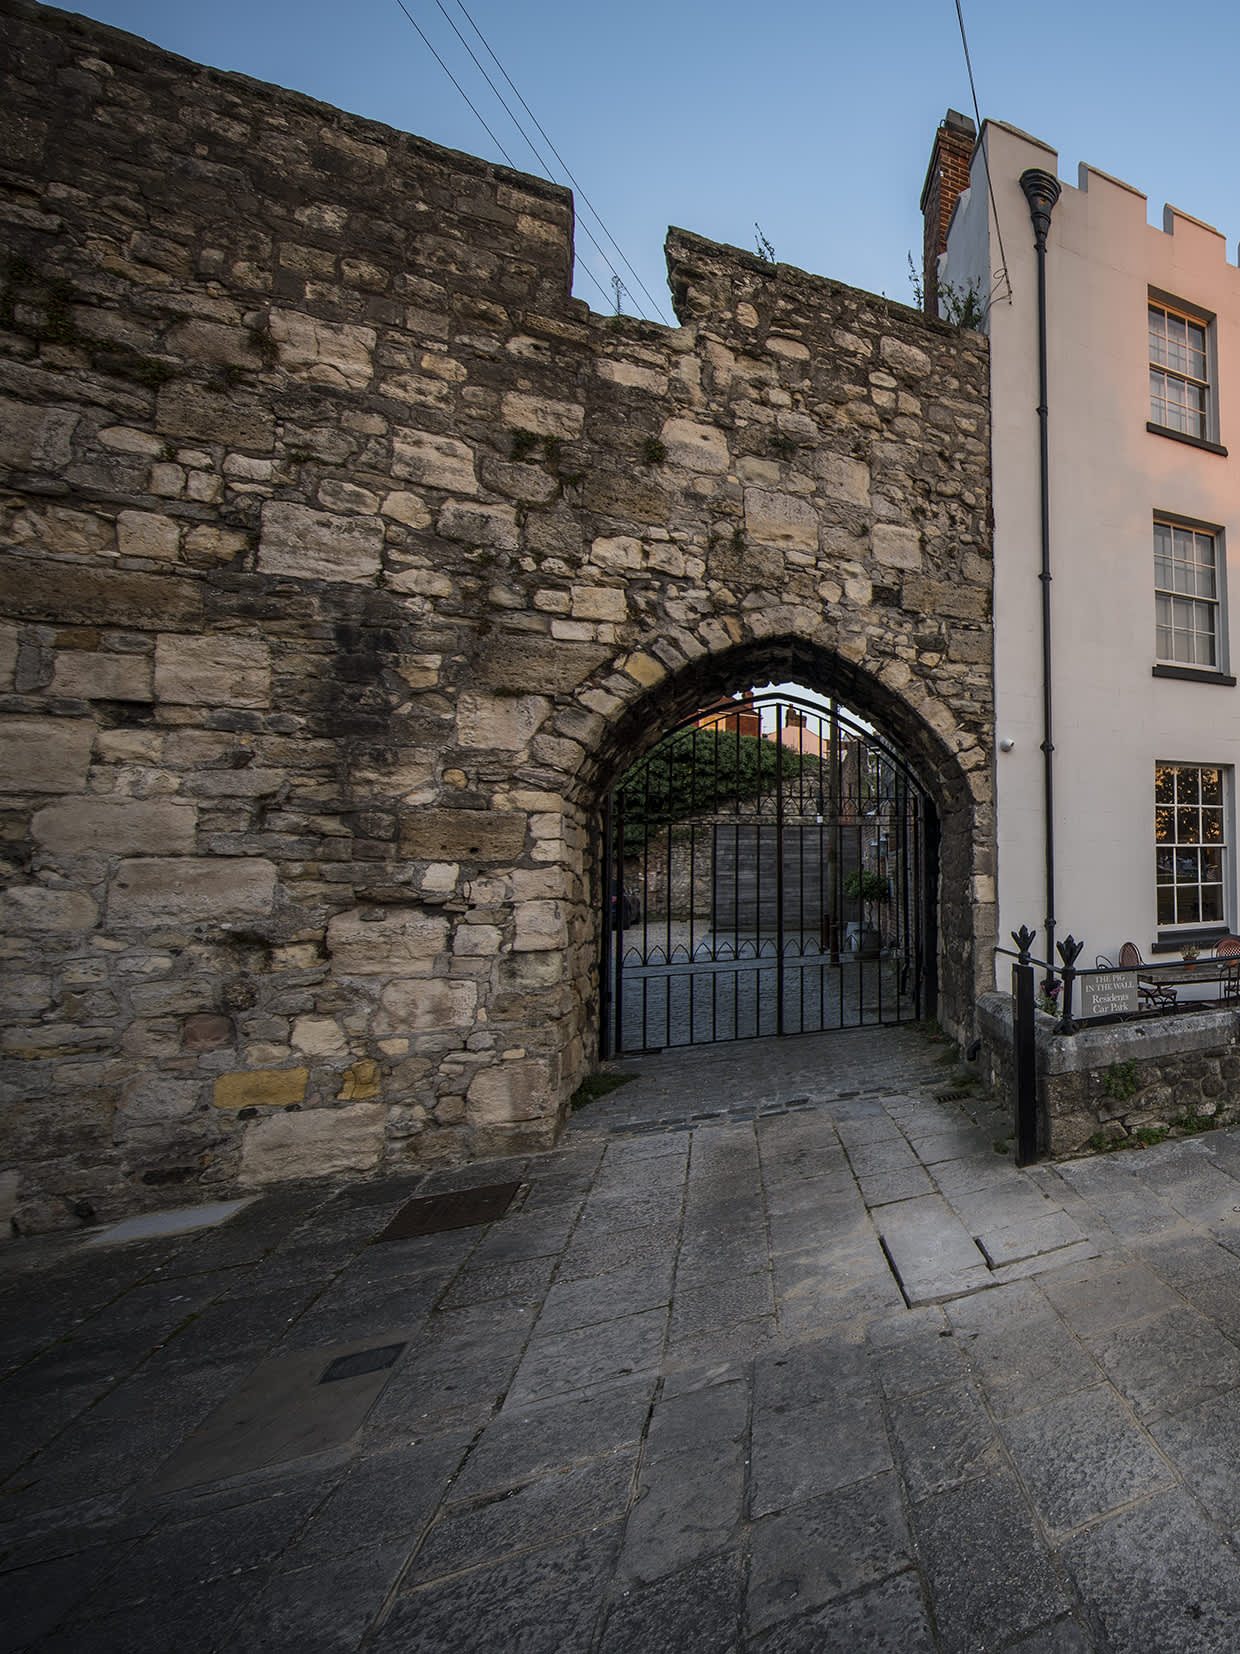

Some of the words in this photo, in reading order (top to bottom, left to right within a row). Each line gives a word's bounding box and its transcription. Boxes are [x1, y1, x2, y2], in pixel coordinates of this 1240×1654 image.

[1096, 975, 1112, 983] THE
[1086, 984, 1095, 992] IN
[1097, 983, 1113, 991] THE
[1113, 982, 1135, 990] WALL
[1092, 993, 1129, 1004] Residents
[1093, 1004, 1109, 1014] Car
[1111, 1002, 1129, 1012] Park
